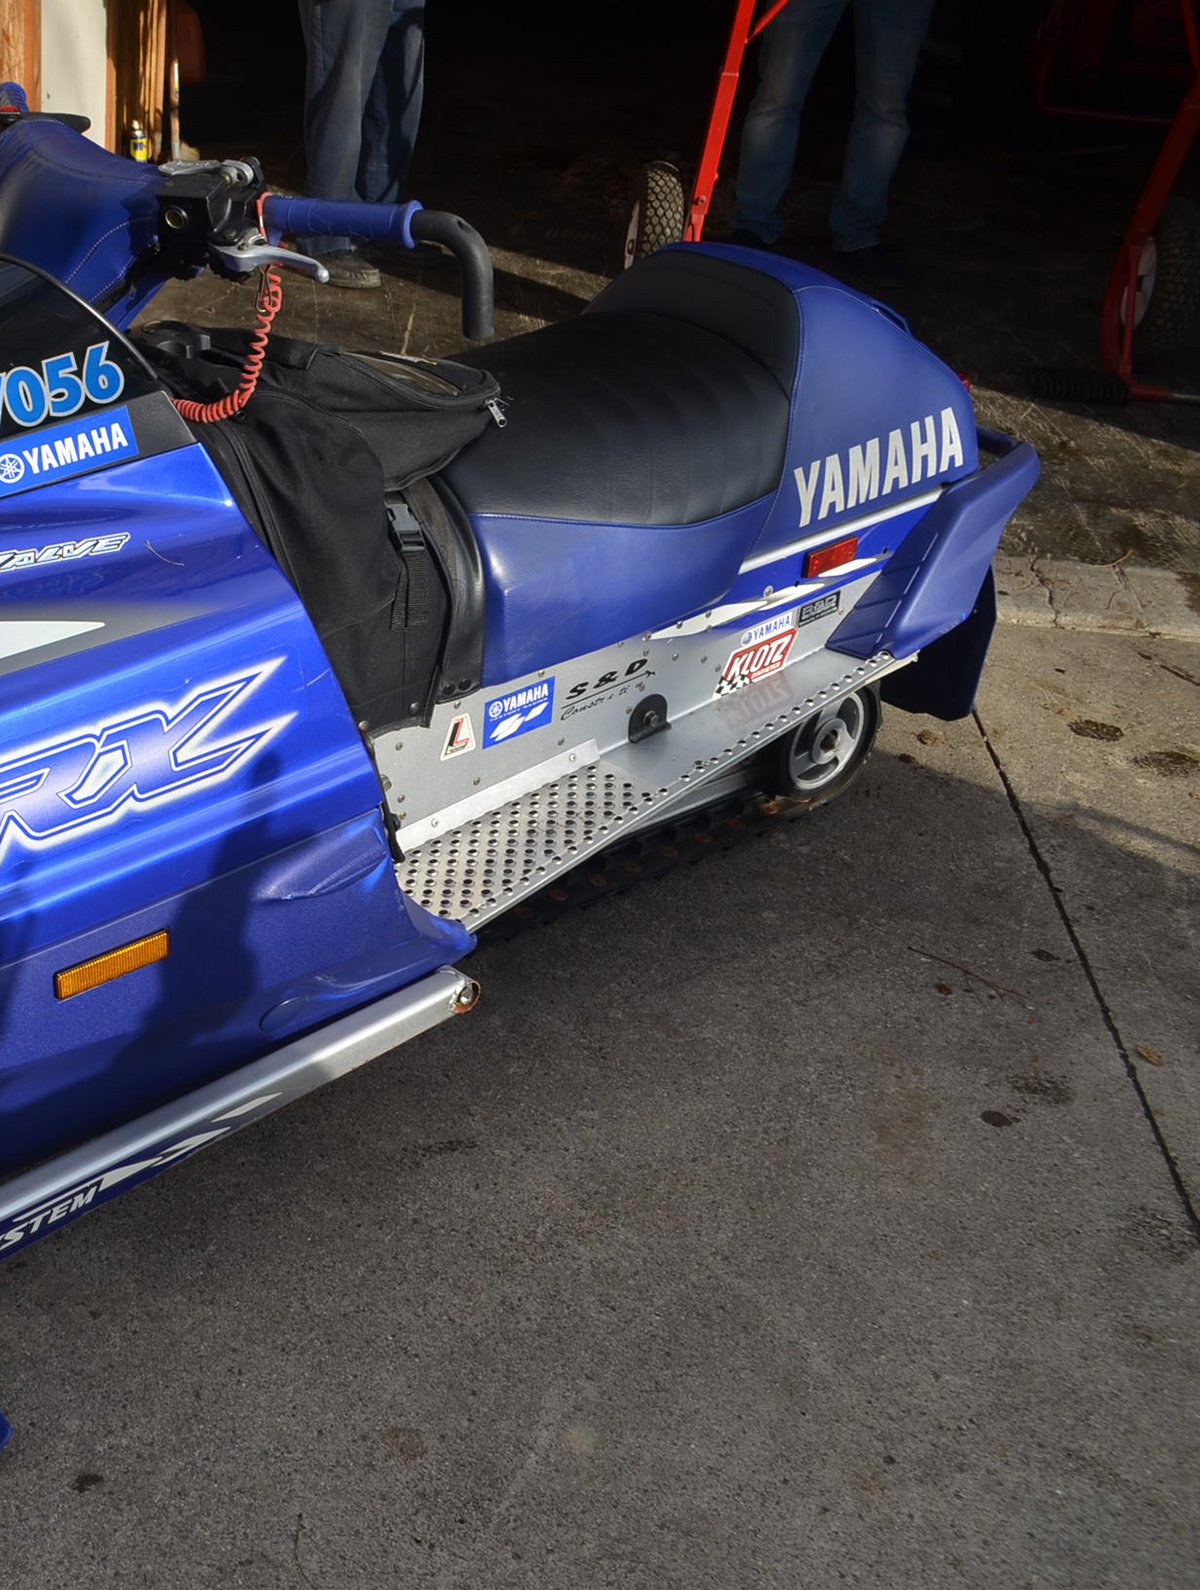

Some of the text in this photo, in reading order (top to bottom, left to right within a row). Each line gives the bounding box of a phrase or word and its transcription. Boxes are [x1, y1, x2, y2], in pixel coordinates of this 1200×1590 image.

[22, 422, 128, 474] YAMAHA
[794, 407, 963, 528] YAMAHA
[753, 615, 790, 641] YAMAHA
[565, 658, 648, 700] S & D
[726, 634, 793, 681] KLOTZ
[503, 683, 549, 712] YAMAHA
